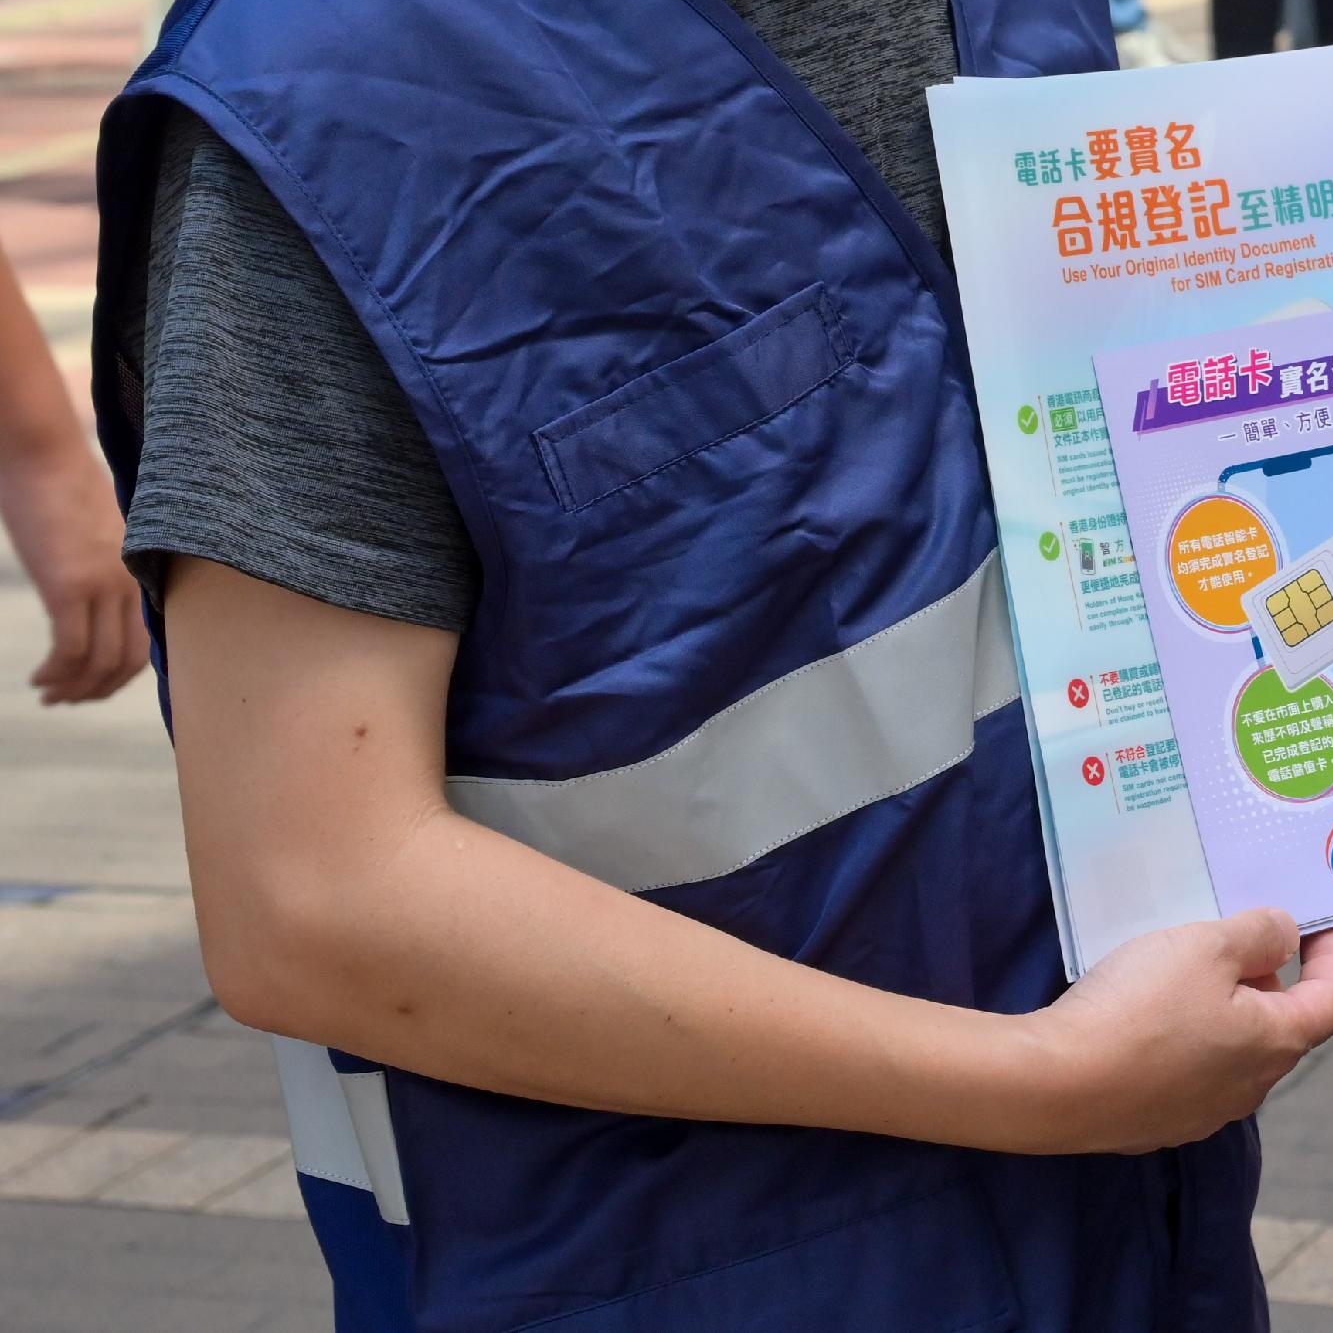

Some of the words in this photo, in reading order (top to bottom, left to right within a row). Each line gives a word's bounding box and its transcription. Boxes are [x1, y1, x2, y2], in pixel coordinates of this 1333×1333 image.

[1013, 121, 1202, 187] 電話卡要實名
[1062, 267, 1088, 285] Use
[1089, 262, 1122, 281] Your
[1125, 256, 1180, 278] Original
[1183, 246, 1237, 268] Identity
[1240, 233, 1317, 259] Document
[1170, 275, 1193, 293] for
[1195, 270, 1222, 290] SIM
[1225, 264, 1260, 284] Card
